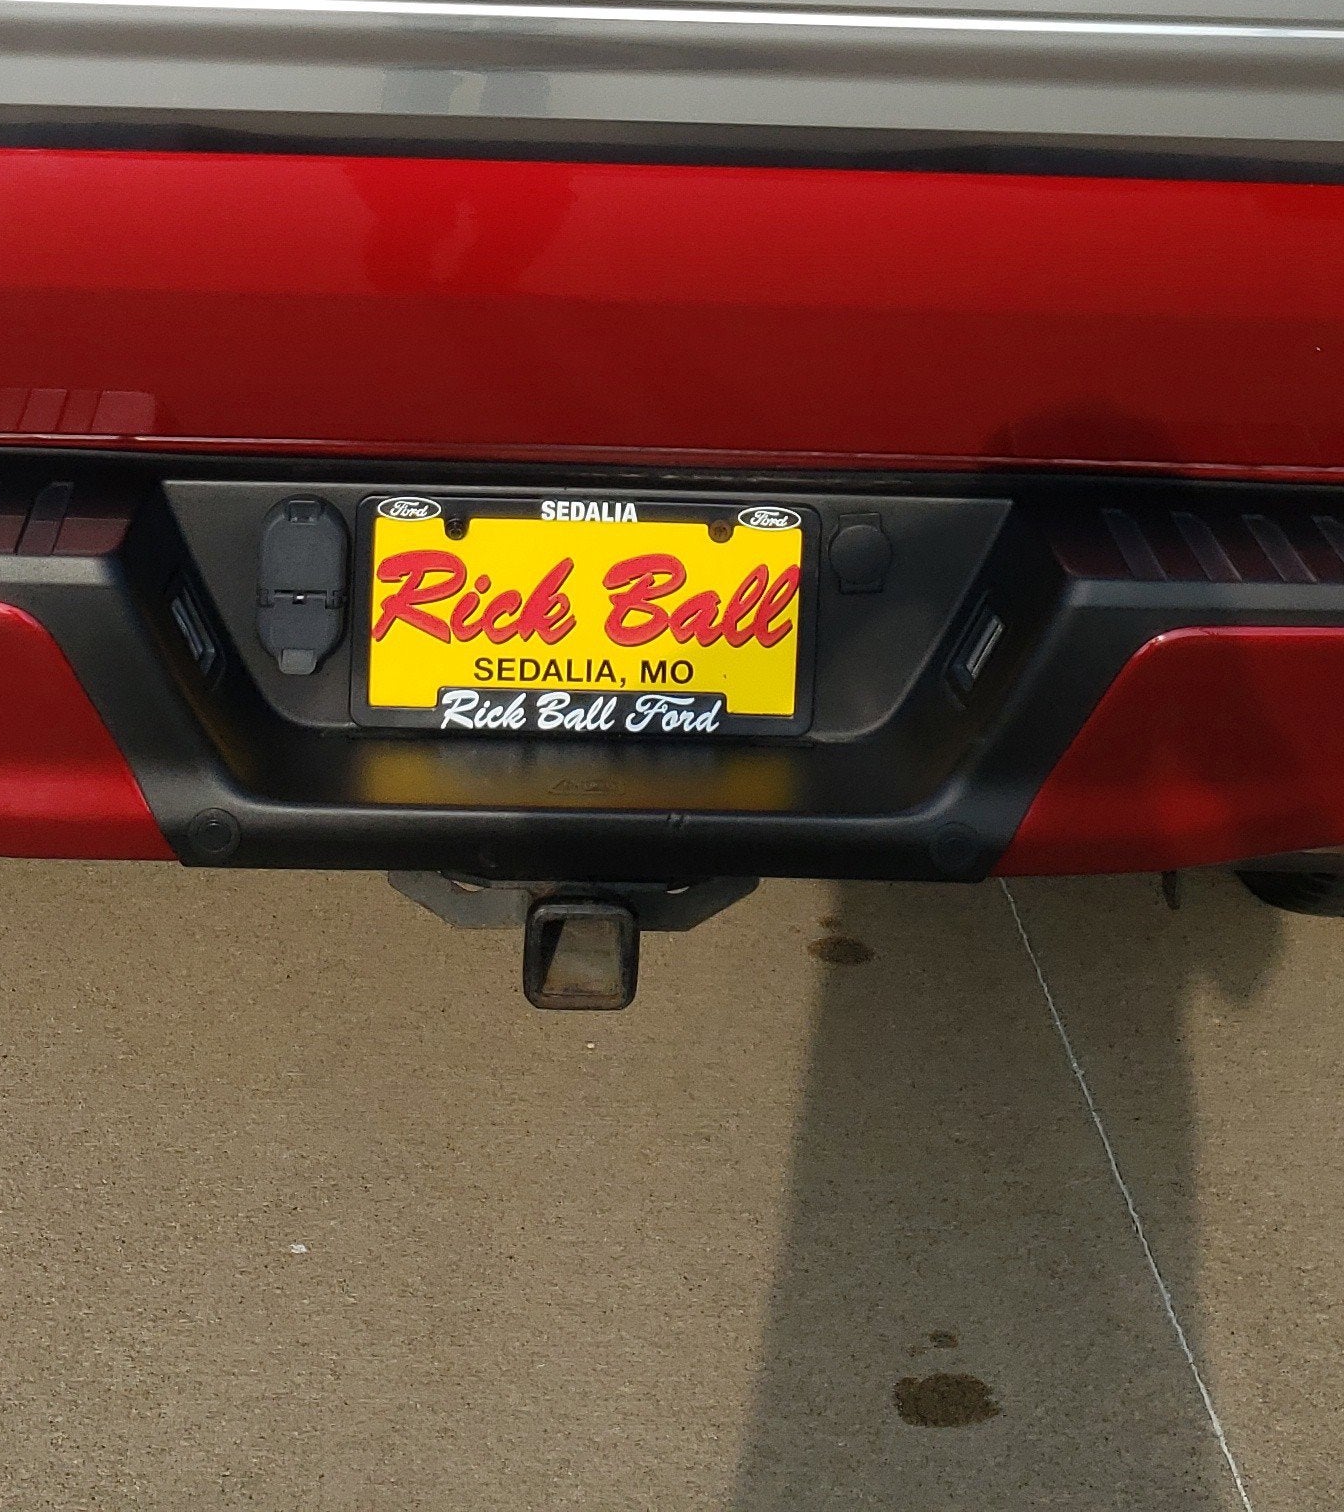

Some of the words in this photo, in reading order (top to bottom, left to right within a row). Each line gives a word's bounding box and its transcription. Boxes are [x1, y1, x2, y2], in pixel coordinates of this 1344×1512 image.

[541, 500, 638, 523] SEDALIA
[371, 549, 577, 644] Rick
[602, 553, 802, 649] Ball
[473, 657, 627, 687] SEDALIA,
[640, 659, 695, 685] MO
[440, 689, 528, 731] Rick
[535, 691, 616, 732] Ball
[625, 693, 722, 733] Ford
